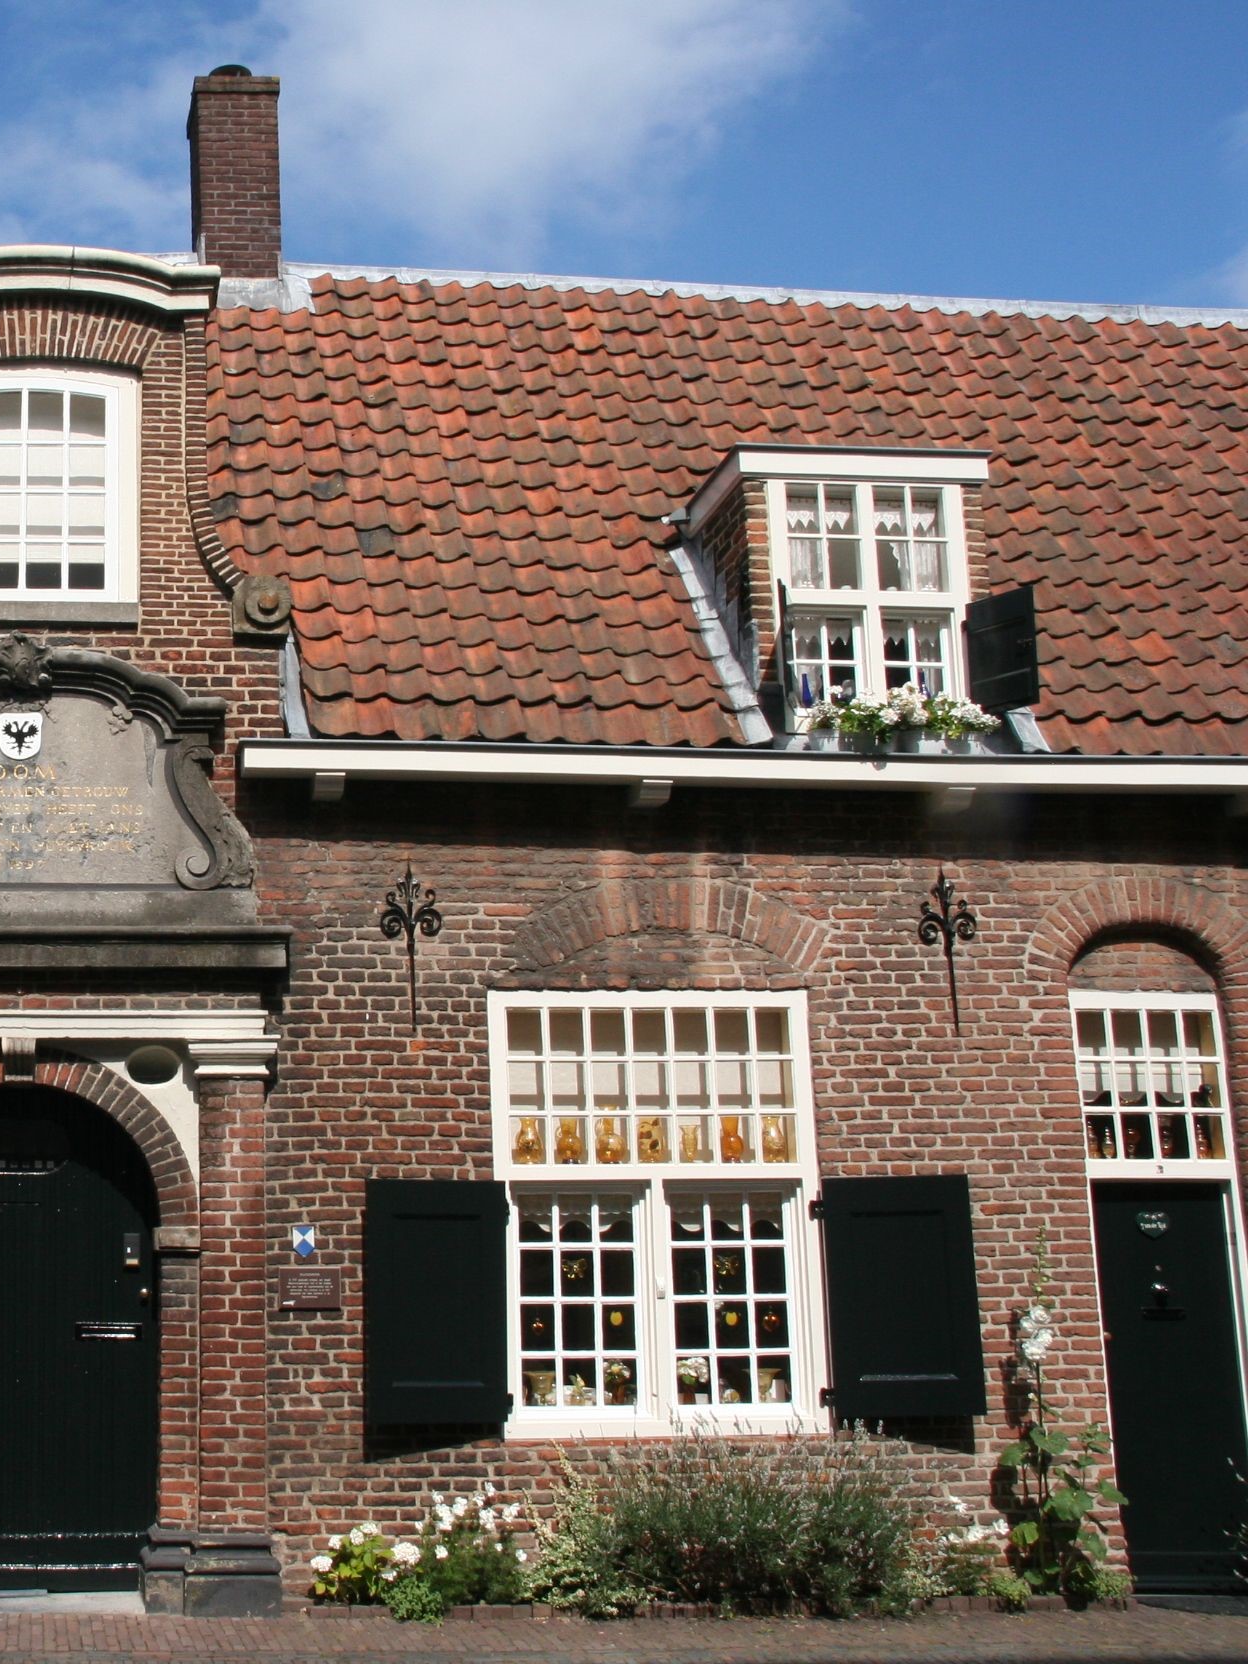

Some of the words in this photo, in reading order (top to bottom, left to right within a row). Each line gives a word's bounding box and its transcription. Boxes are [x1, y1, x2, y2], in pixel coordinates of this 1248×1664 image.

[46, 803, 97, 815] HEEFT
[110, 803, 144, 816] ONS
[11, 822, 33, 834] EN
[46, 822, 90, 834] AET
